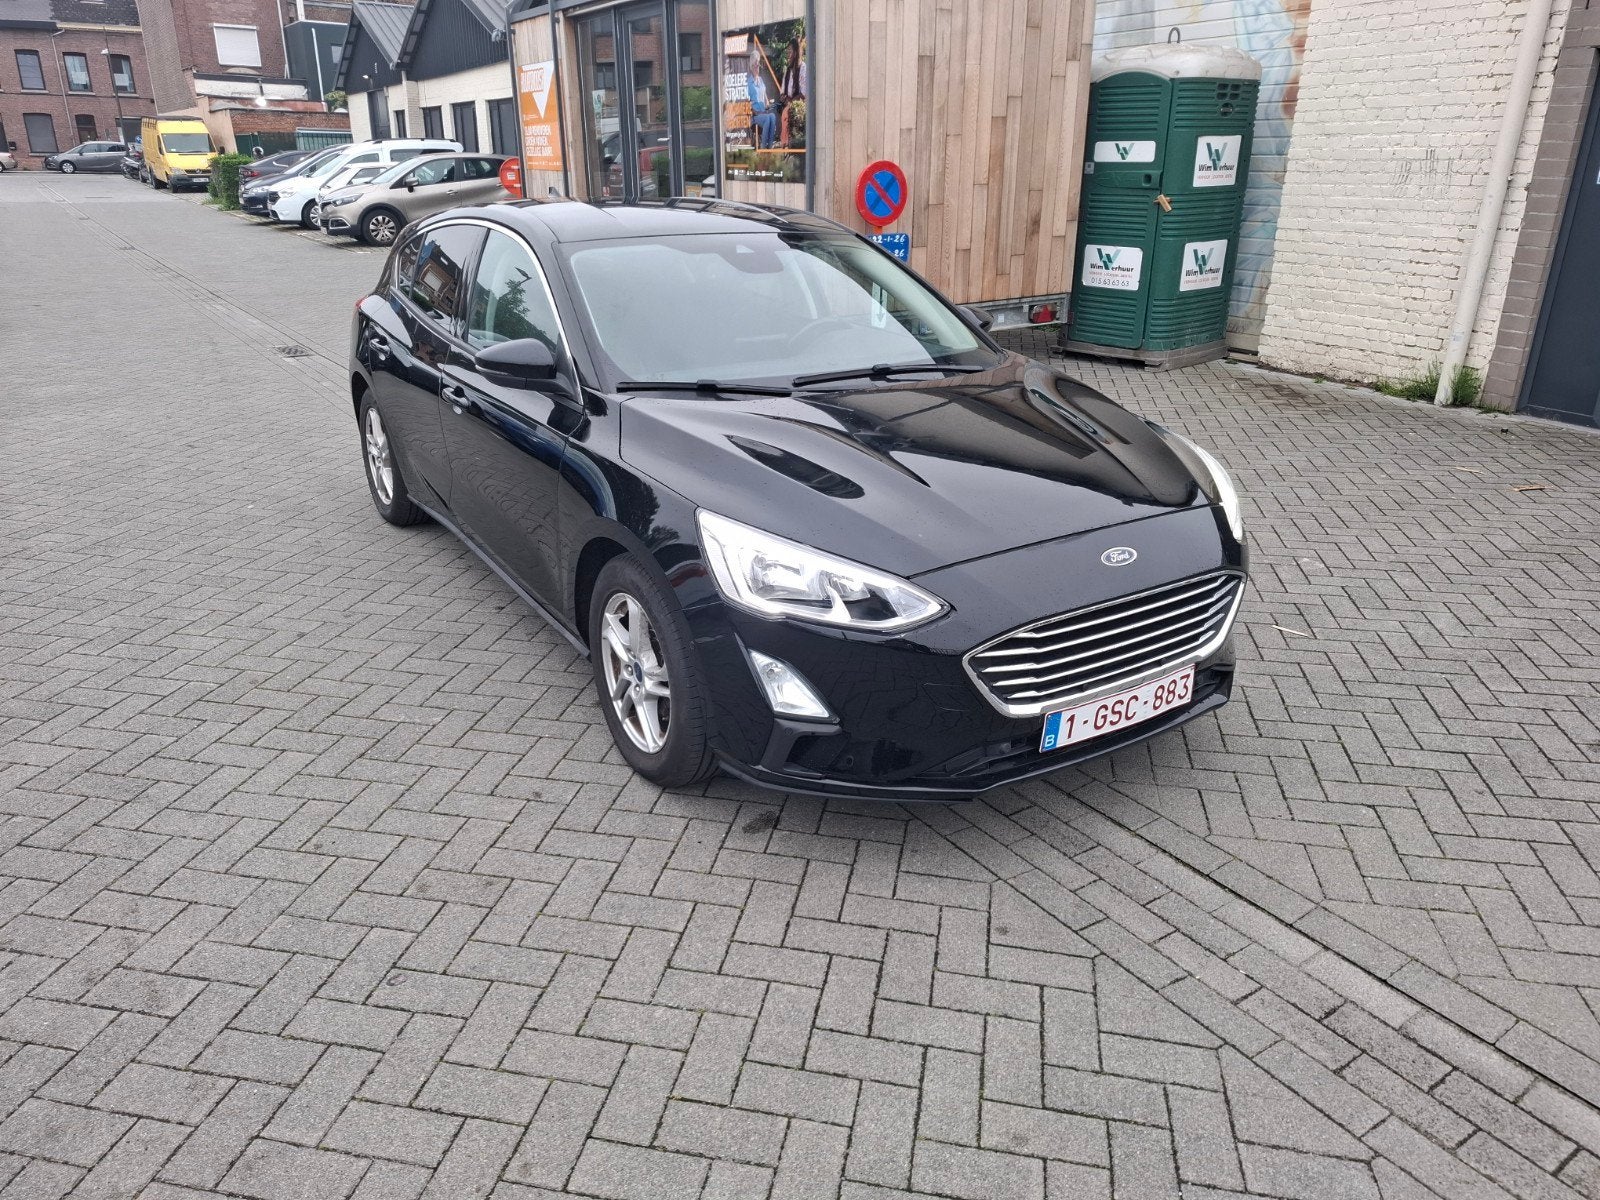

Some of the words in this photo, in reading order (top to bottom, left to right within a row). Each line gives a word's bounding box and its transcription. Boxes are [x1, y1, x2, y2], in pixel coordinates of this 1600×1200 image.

[1090, 262, 1104, 270] Wim
[1110, 550, 1131, 562] Ford
[1044, 734, 1055, 747] B
[1066, 673, 1191, 739] 1-GSC-883
